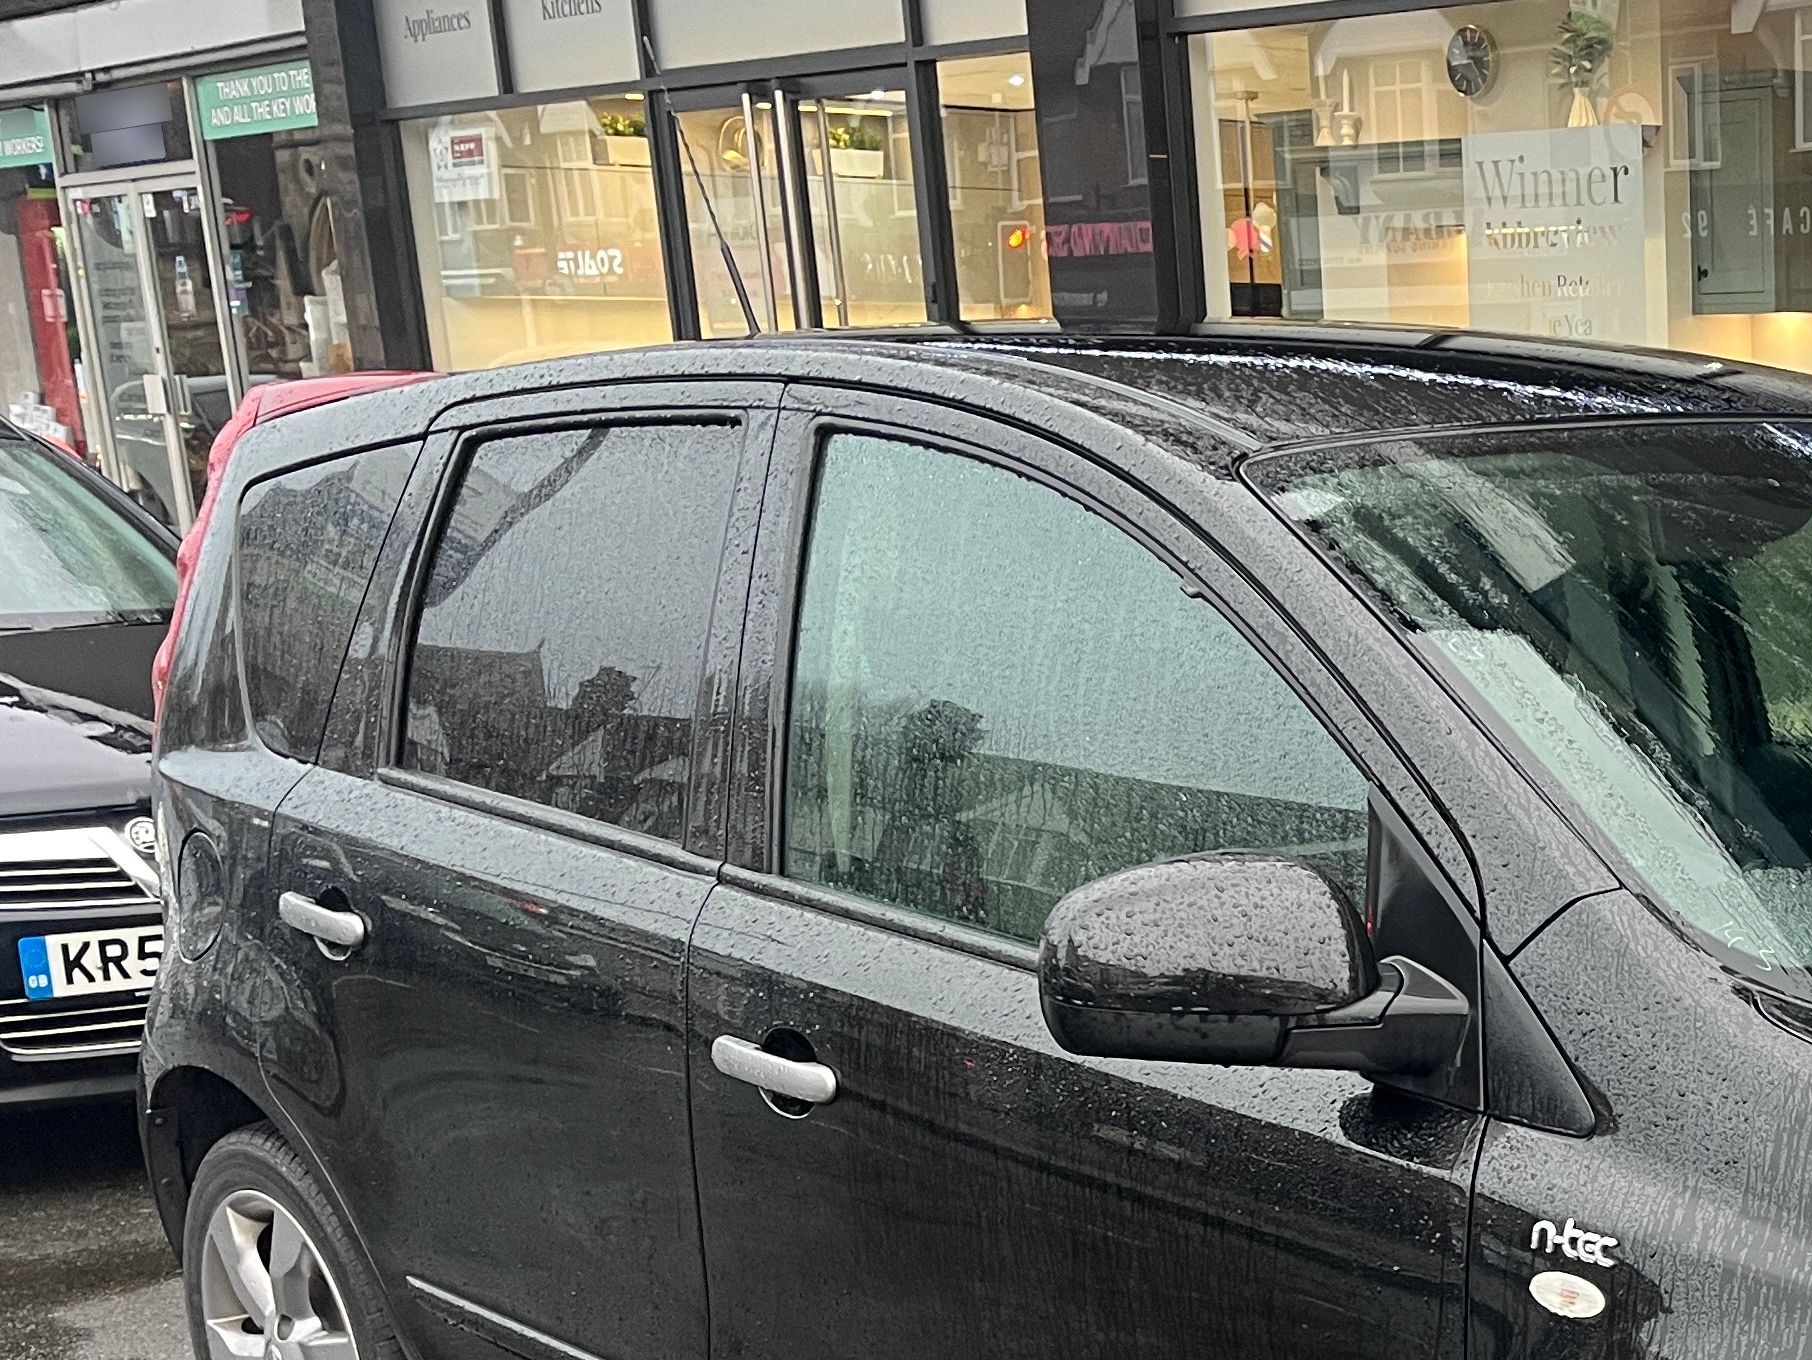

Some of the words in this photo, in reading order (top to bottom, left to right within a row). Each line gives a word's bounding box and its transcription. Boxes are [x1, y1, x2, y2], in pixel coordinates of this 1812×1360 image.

[404, 9, 472, 42] Appliances
[216, 78, 252, 100] THANK
[251, 75, 273, 95] YOU
[273, 72, 289, 91] TO
[288, 68, 310, 90] THE
[211, 106, 233, 127] AND
[233, 104, 252, 123] ALL
[250, 101, 272, 121] THE
[272, 97, 291, 118] KEY
[1475, 154, 1630, 210] Winner
